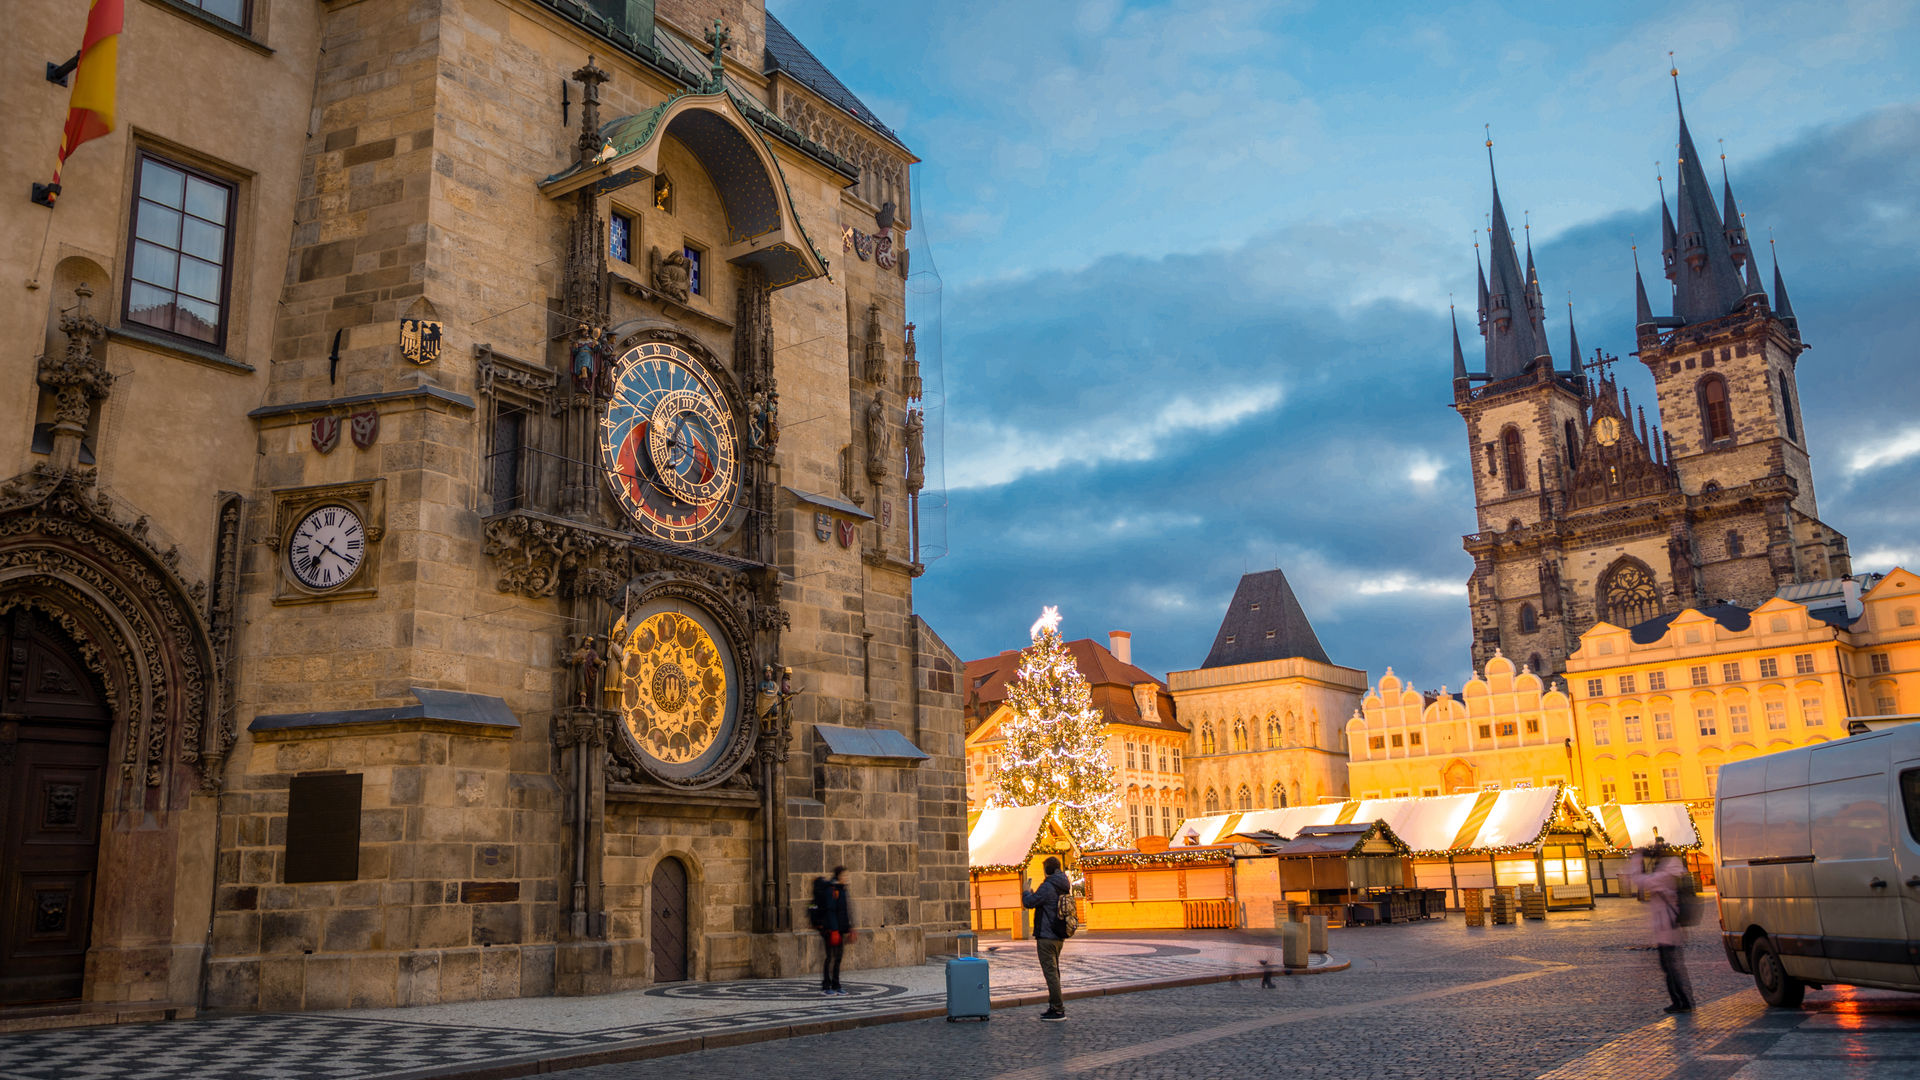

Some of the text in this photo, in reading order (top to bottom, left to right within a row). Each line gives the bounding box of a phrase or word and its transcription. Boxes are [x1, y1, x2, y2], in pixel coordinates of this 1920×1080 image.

[311, 517, 322, 532] XI
[324, 512, 335, 527] XII
[338, 515, 346, 528] I
[300, 530, 312, 540] X
[345, 526, 358, 536] II
[296, 544, 309, 554] IX
[347, 540, 360, 550] III
[324, 568, 331, 582] VI
[337, 564, 344, 577] V
